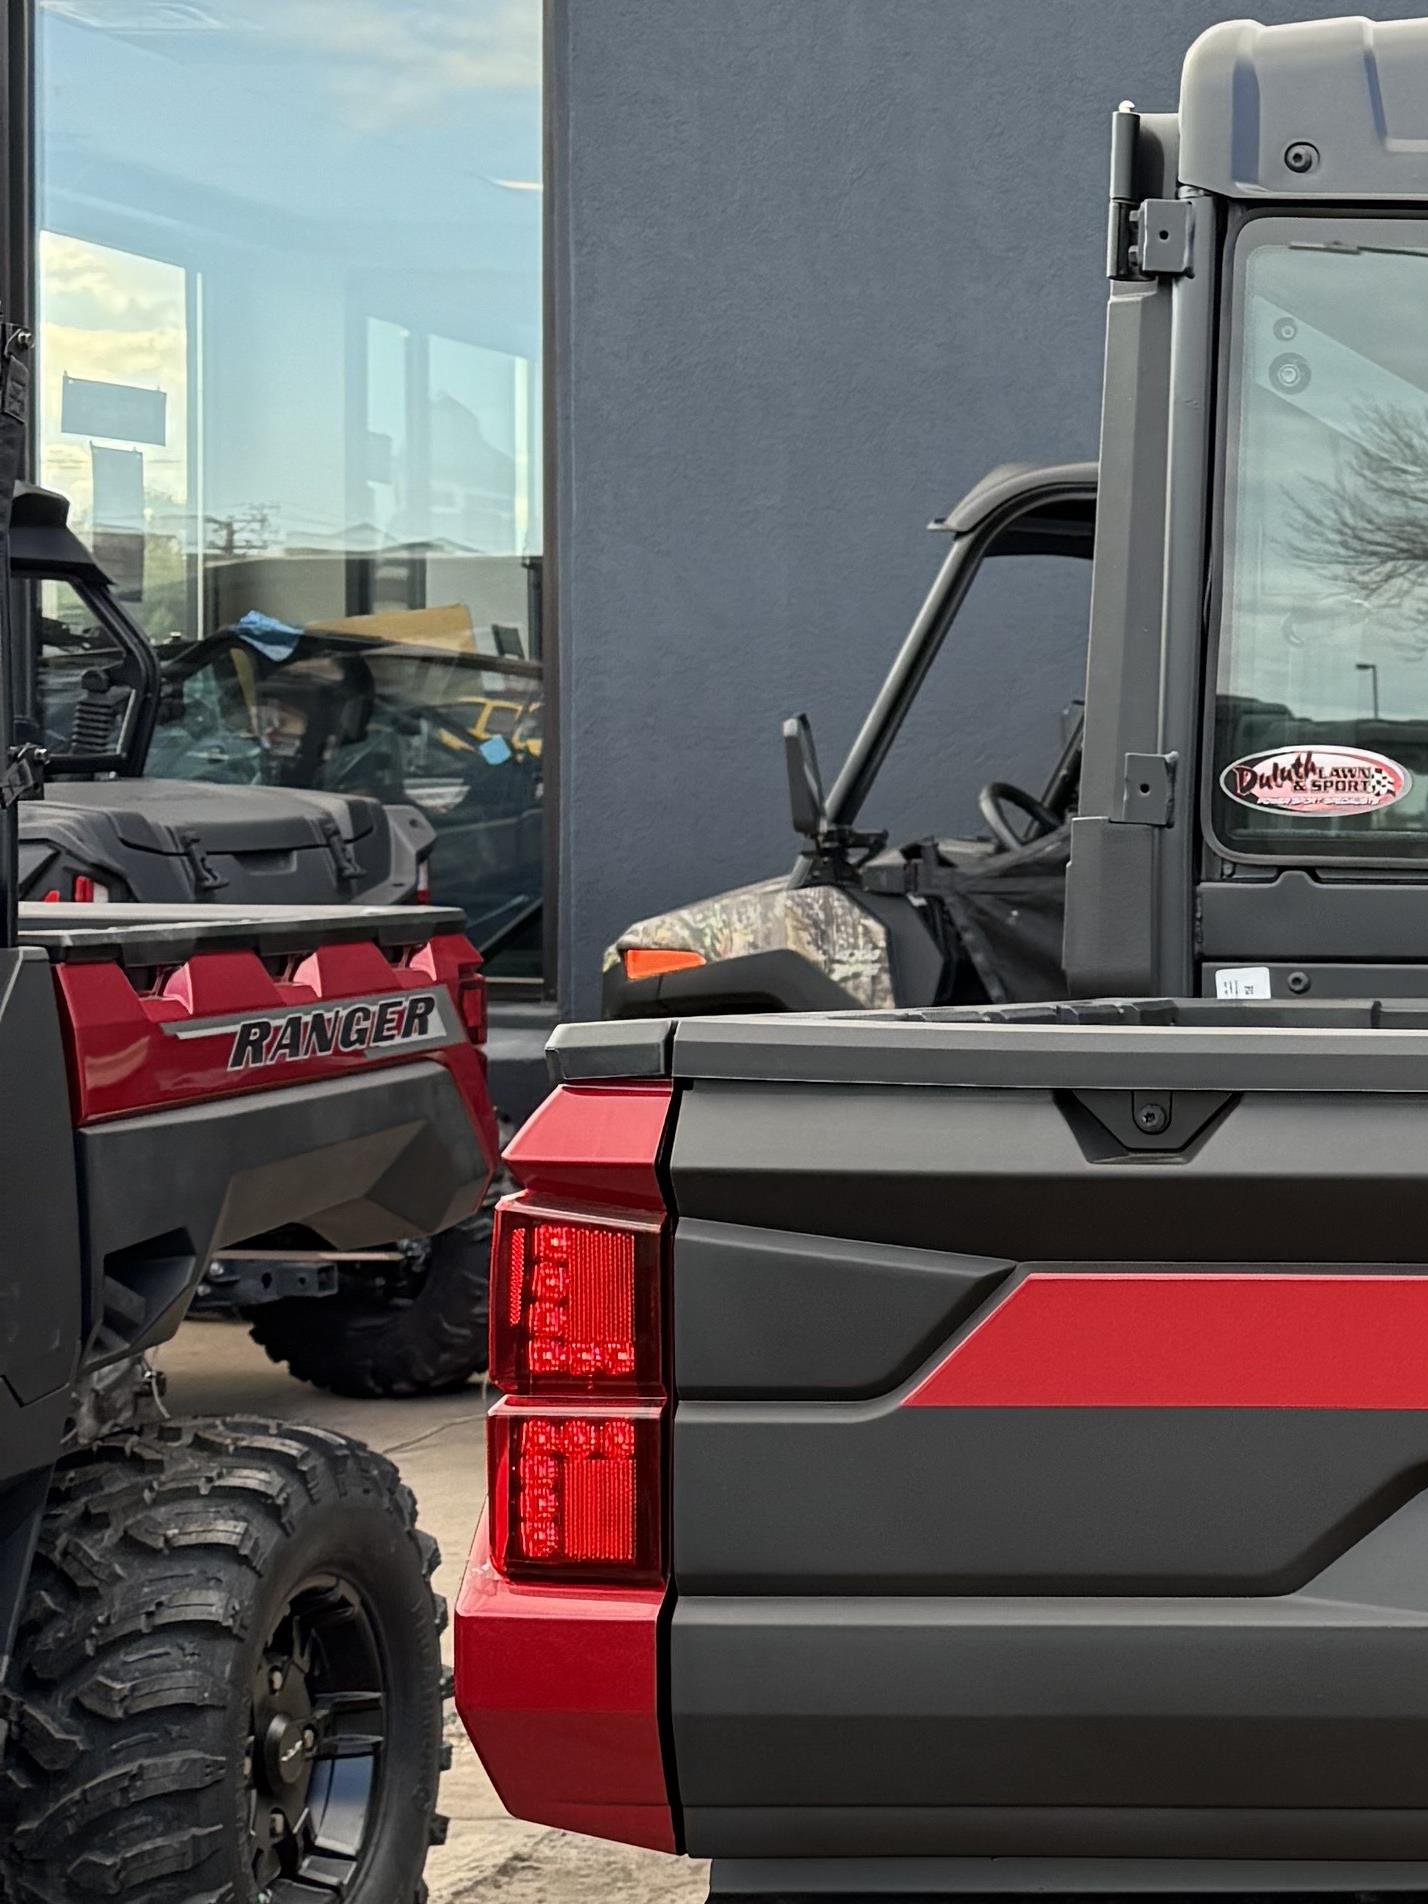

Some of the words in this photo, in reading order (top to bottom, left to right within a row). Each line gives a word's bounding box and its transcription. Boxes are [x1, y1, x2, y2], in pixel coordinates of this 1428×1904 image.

[1233, 750, 1317, 795] Duluth
[1317, 766, 1372, 779] LAWN
[1293, 779, 1306, 792] &
[1310, 779, 1369, 793] SPORT
[227, 995, 436, 1071] RANGER
